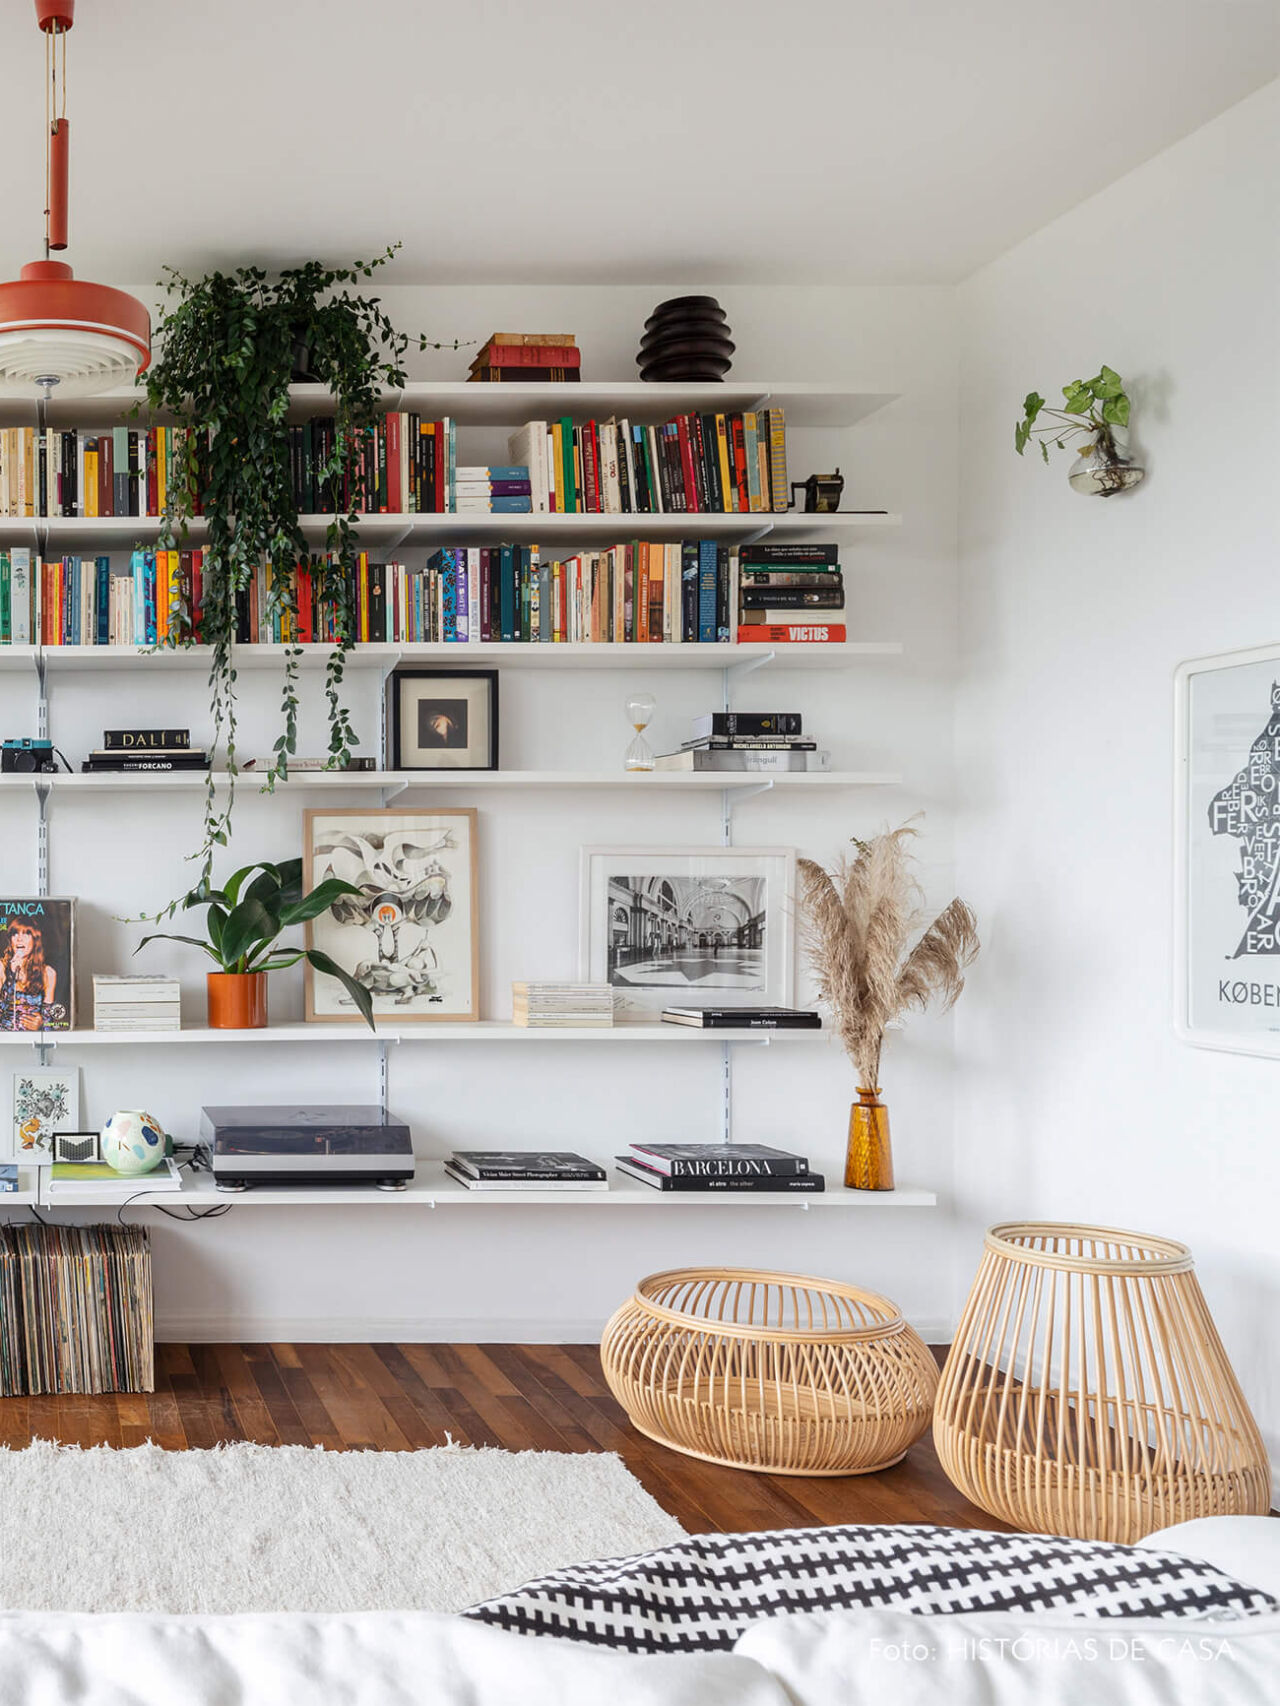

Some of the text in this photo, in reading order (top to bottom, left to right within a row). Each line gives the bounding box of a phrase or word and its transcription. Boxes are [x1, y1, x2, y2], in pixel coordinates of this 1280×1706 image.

[458, 560, 466, 586] PATTI
[788, 627, 829, 640] VICTUS
[122, 731, 166, 746] DALÍ
[1219, 980, 1280, 1008] KØBE
[674, 1160, 772, 1175] BARCELONA
